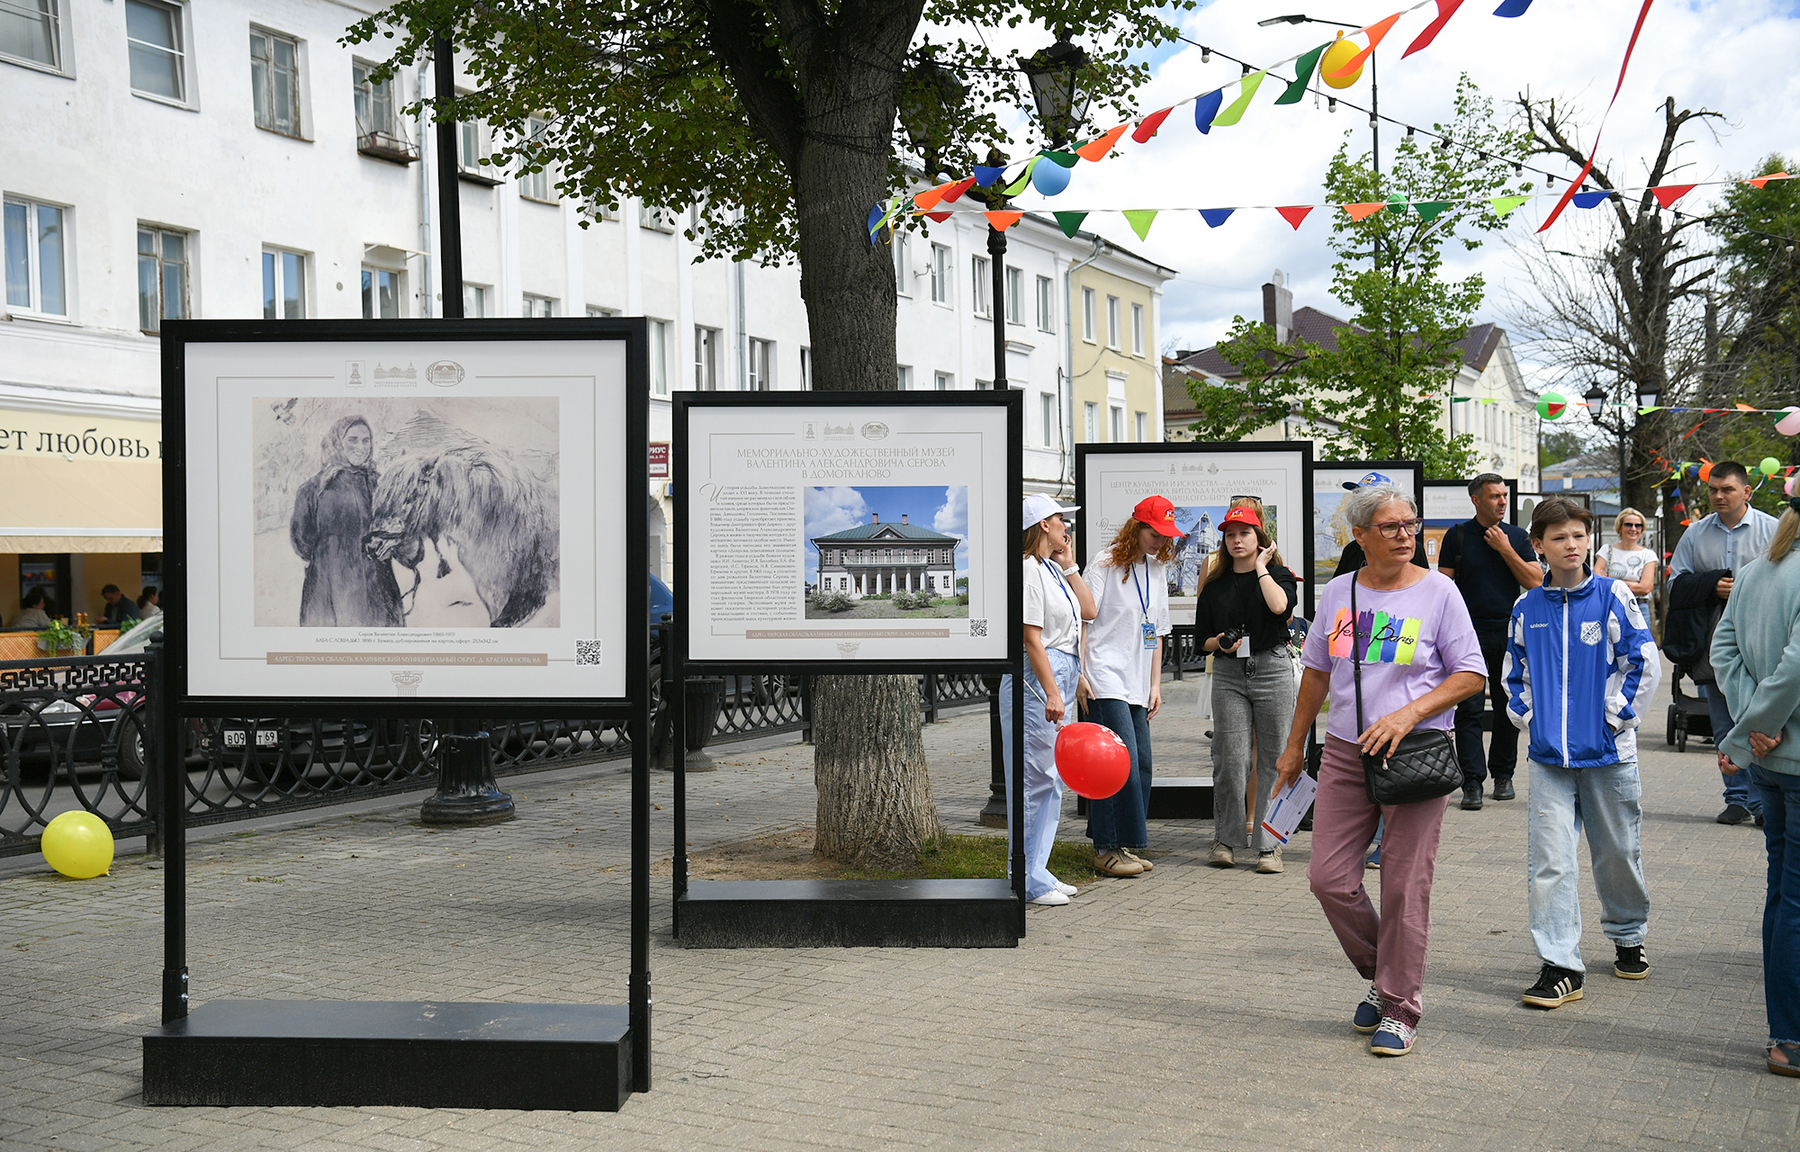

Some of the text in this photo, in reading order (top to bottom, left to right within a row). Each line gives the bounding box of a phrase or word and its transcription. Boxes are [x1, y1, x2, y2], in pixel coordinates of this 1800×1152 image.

[36, 427, 150, 458] любовь
[737, 446, 955, 458] МЕМОРИАЛЬНО-ХУДОЖЕСТВЕННЫЙ МУЗЕЙ
[746, 458, 946, 468] ВАЛЕНТИНА АЛЕКСАНДРОВИЧА СЕРОВА
[802, 469, 891, 479] В ДОМОТКАНОВО
[1368, 622, 1415, 647] Paris
